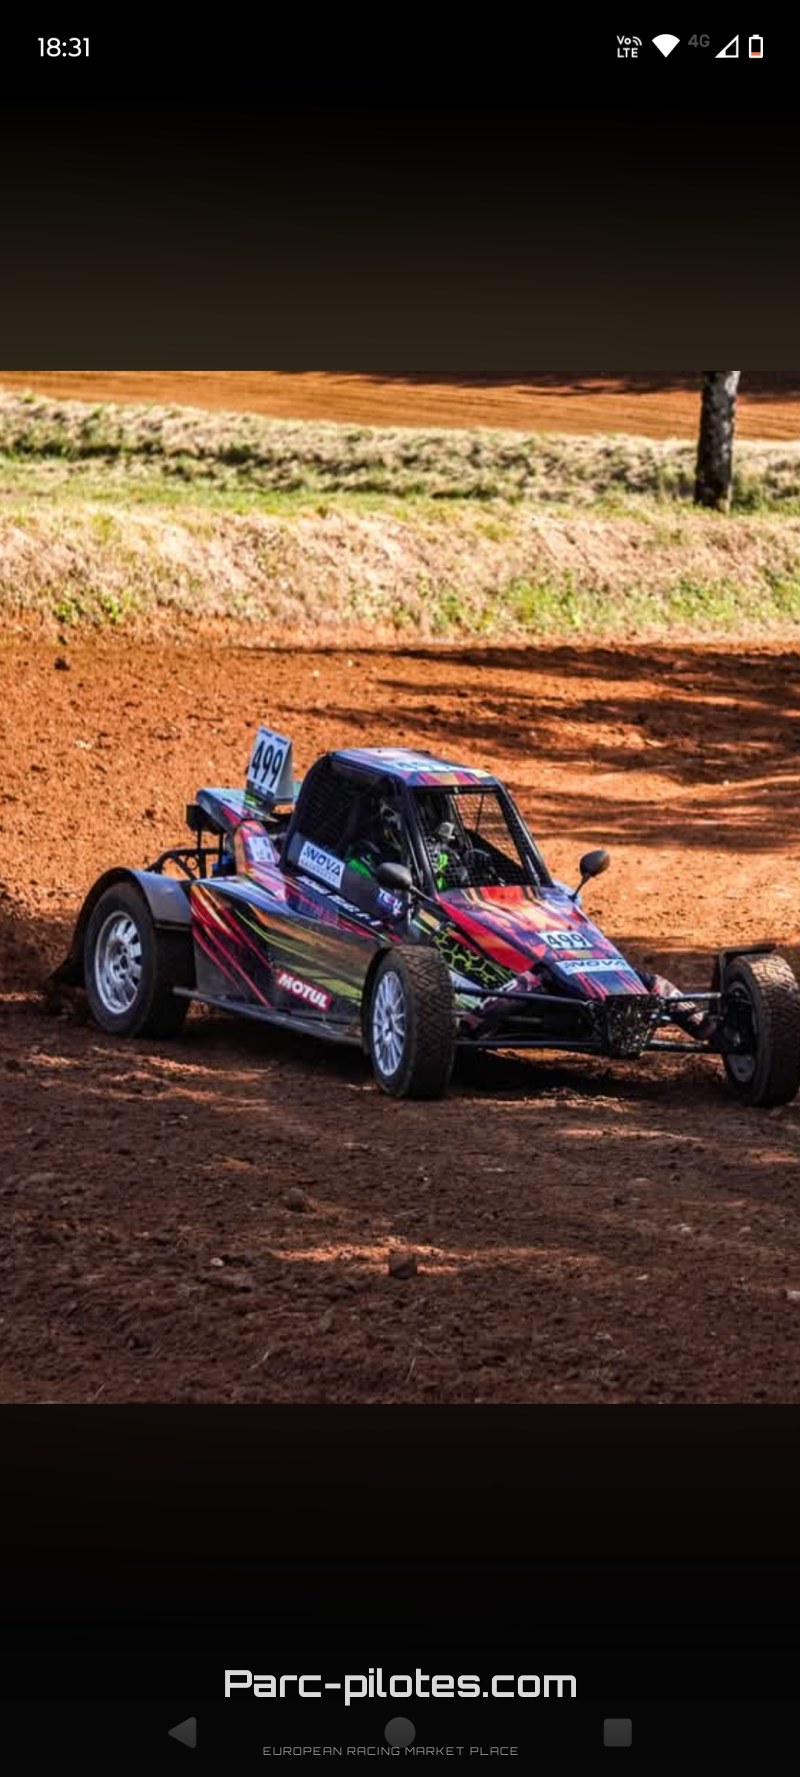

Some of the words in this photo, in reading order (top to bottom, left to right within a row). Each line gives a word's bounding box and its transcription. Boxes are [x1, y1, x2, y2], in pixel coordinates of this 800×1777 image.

[251, 740, 284, 789] 499
[546, 933, 588, 947] 499
[278, 972, 328, 1009] MOTUL
